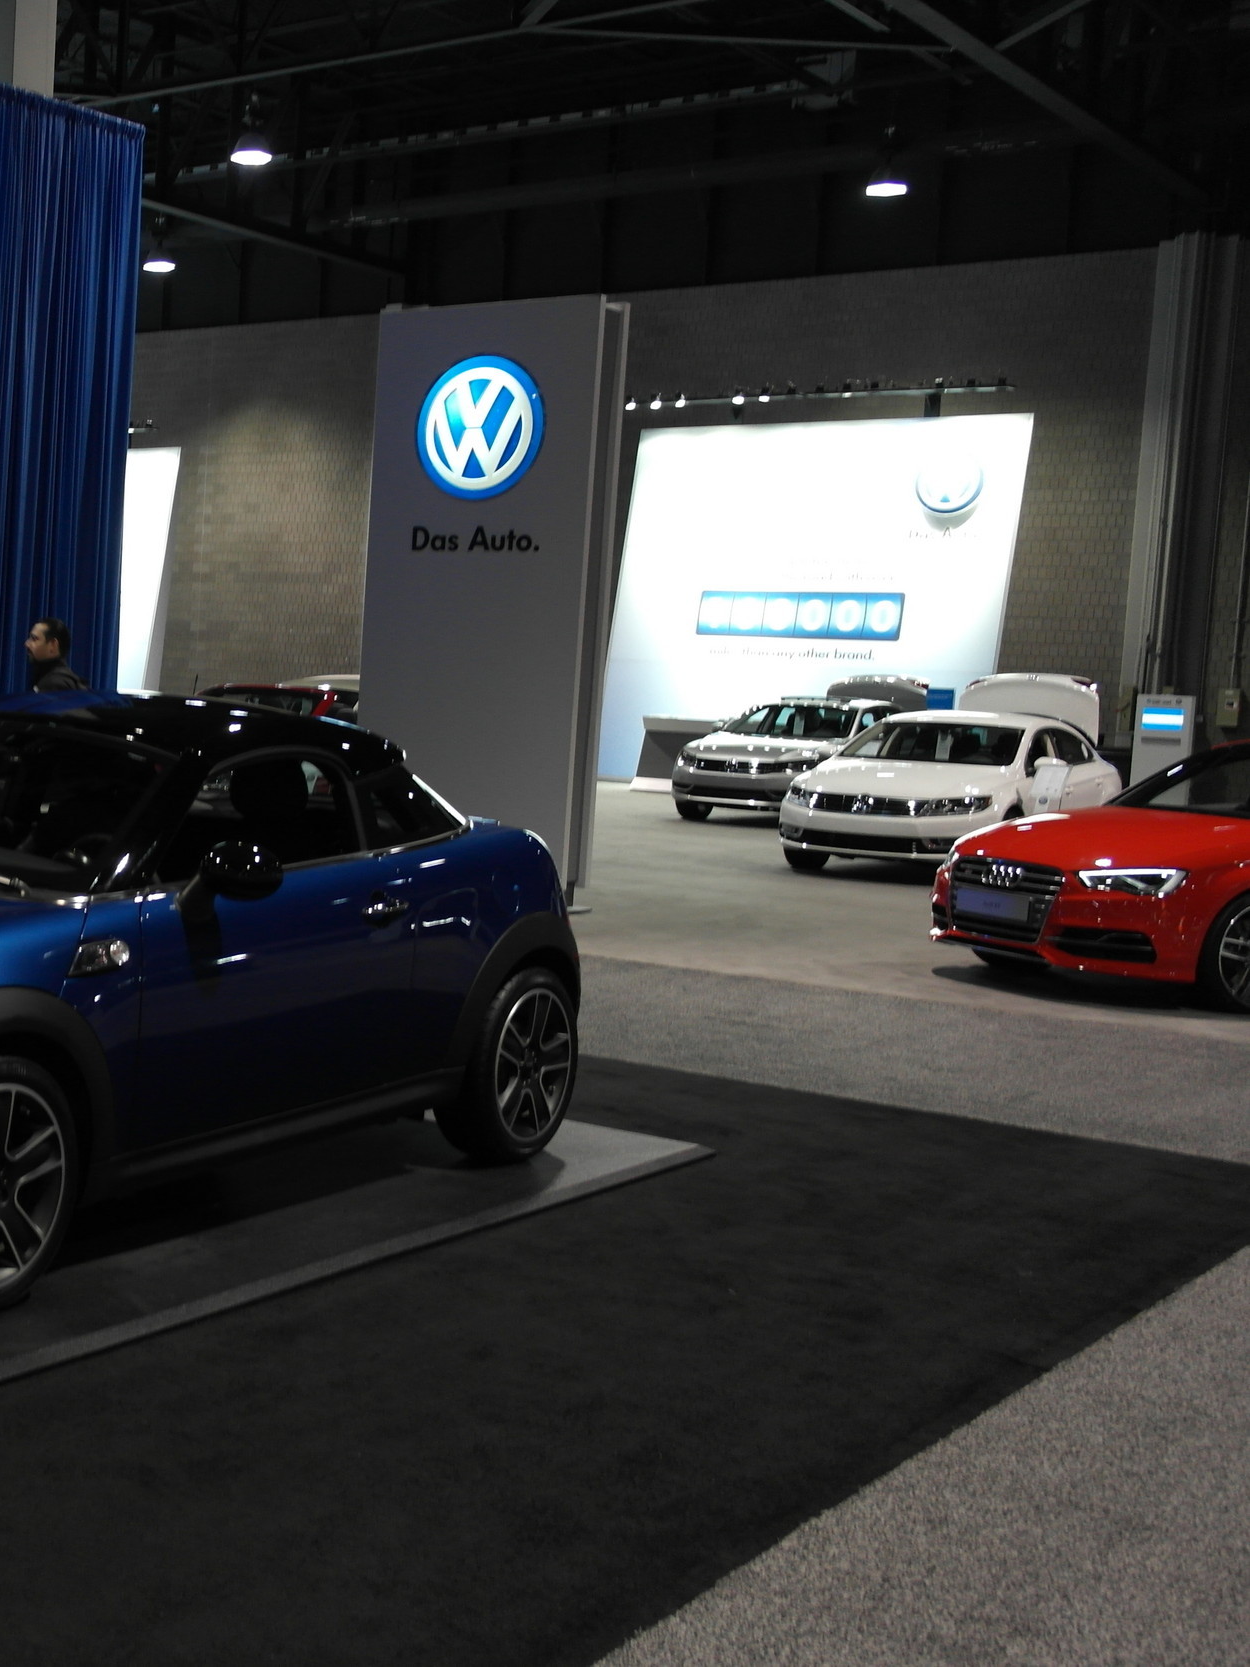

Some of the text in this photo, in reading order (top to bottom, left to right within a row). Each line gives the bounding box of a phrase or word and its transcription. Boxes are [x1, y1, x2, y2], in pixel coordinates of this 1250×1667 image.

[411, 525, 540, 552] Das Auto.
[798, 647, 830, 658] other
[834, 648, 875, 660] brand.
